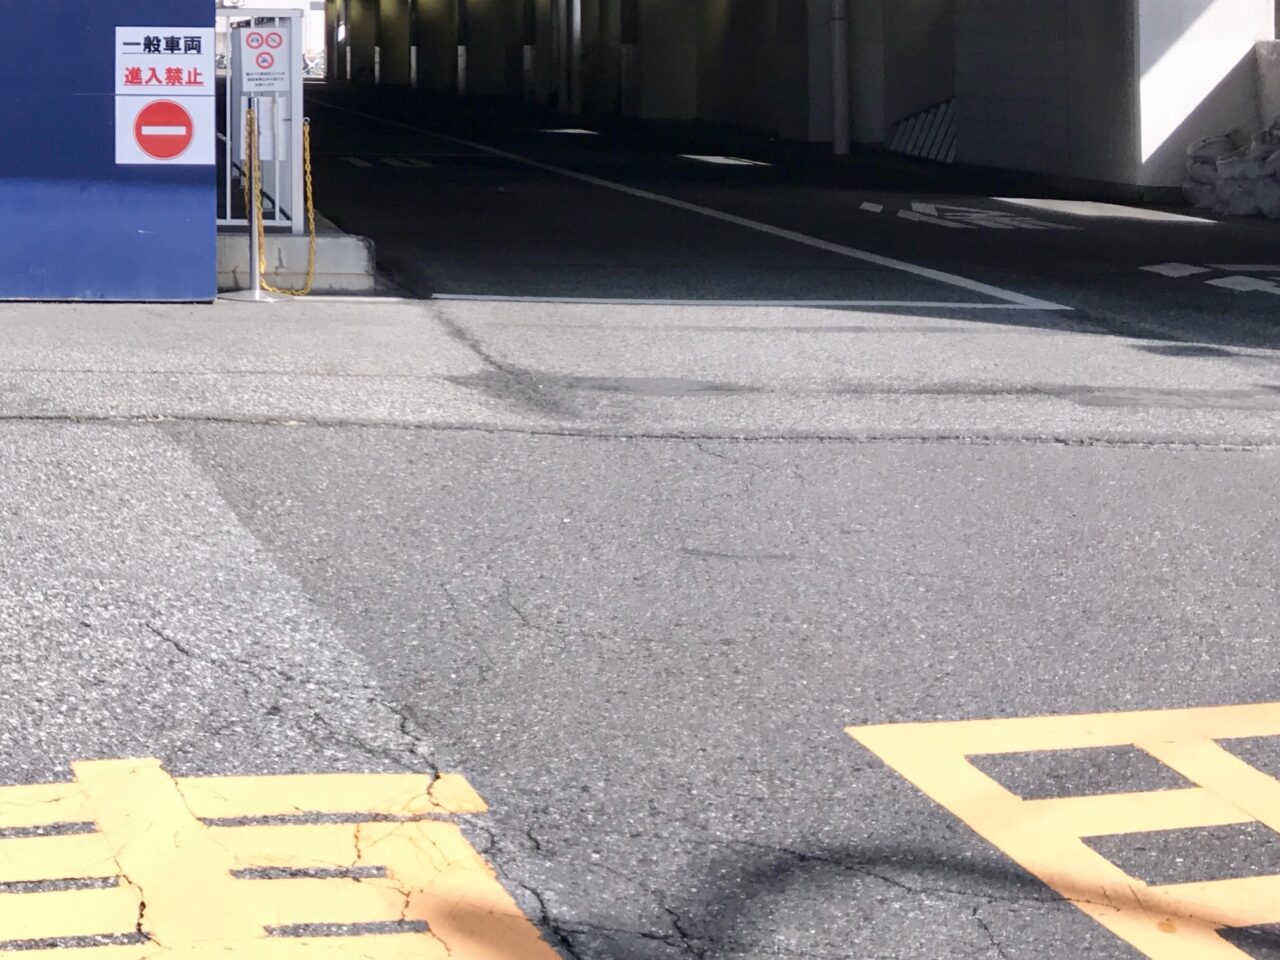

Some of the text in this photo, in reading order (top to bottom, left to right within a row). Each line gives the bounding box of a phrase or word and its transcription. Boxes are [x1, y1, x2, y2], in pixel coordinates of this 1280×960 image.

[122, 35, 202, 54] 一般車両
[124, 66, 204, 85] 進入禁止
